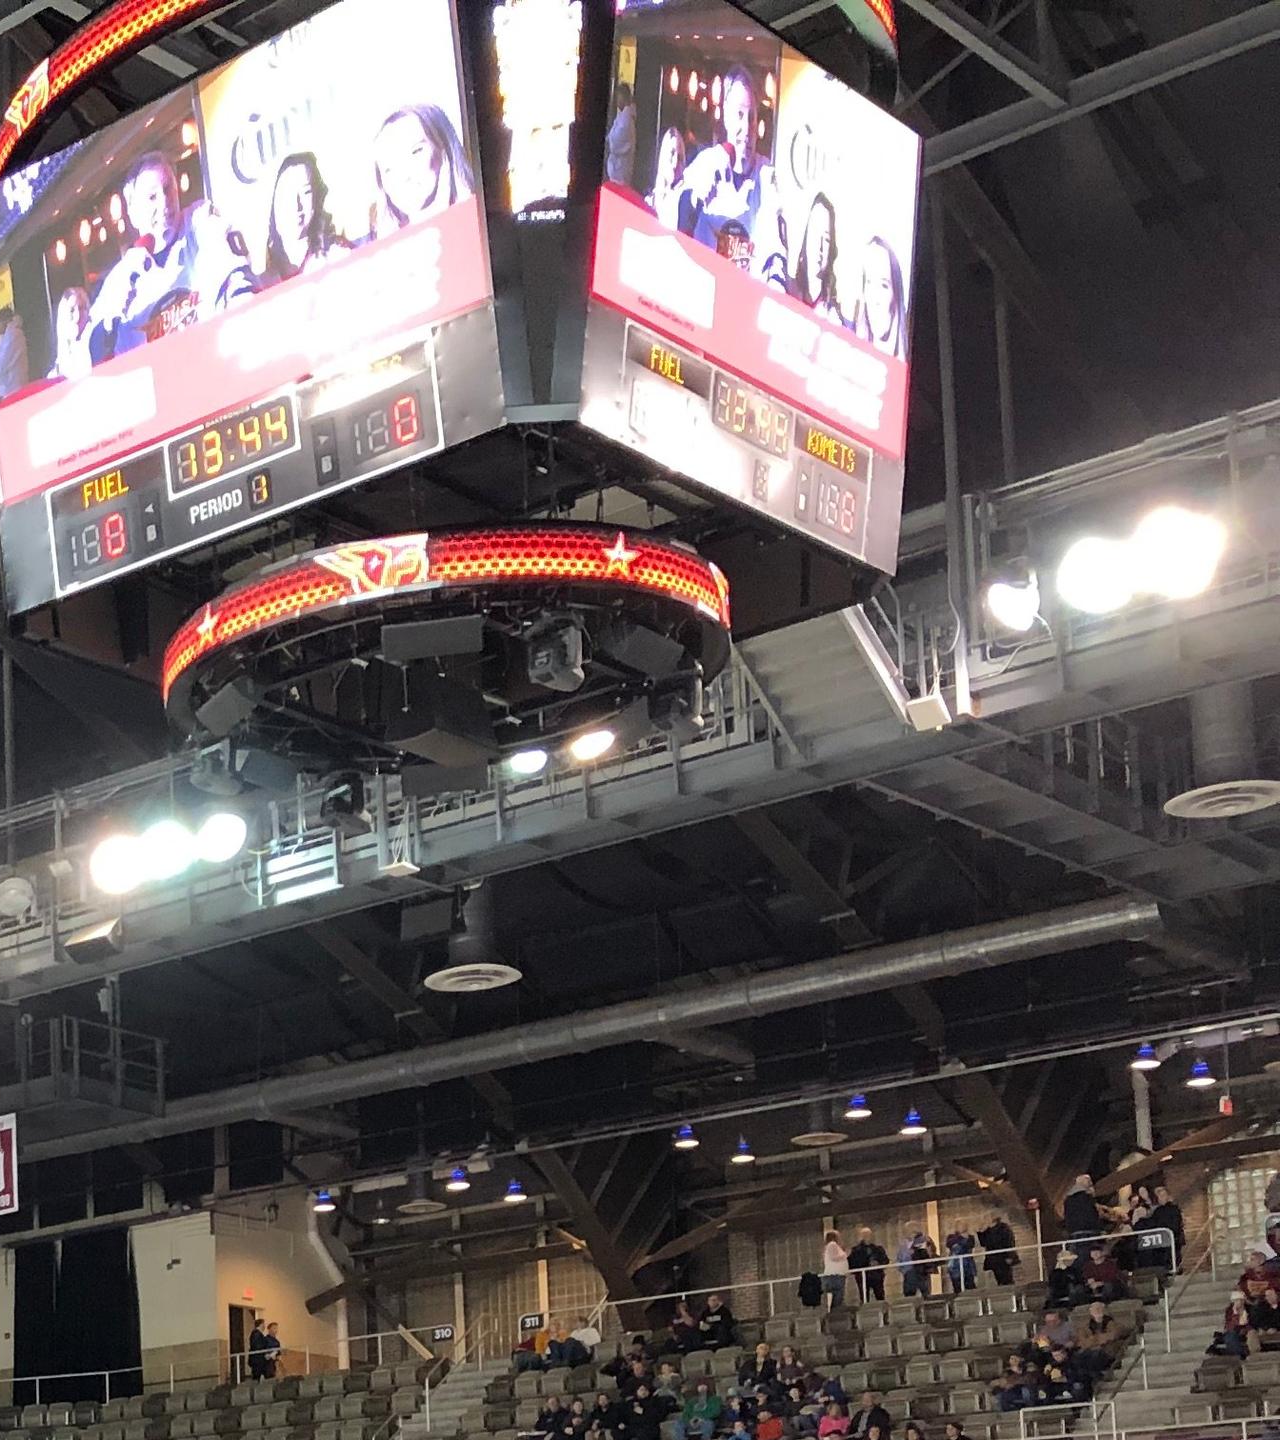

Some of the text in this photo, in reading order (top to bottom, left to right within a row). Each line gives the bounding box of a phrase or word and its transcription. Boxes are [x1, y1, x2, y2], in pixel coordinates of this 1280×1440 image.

[649, 343, 686, 385] FUEL
[180, 404, 288, 484] 13:44
[806, 427, 856, 473] KOMETS
[82, 468, 130, 508] FUEL
[189, 488, 244, 526] PERIOD
[1142, 1233, 1162, 1248] 311
[433, 1327, 452, 1340] 310
[524, 1316, 539, 1328] 311
